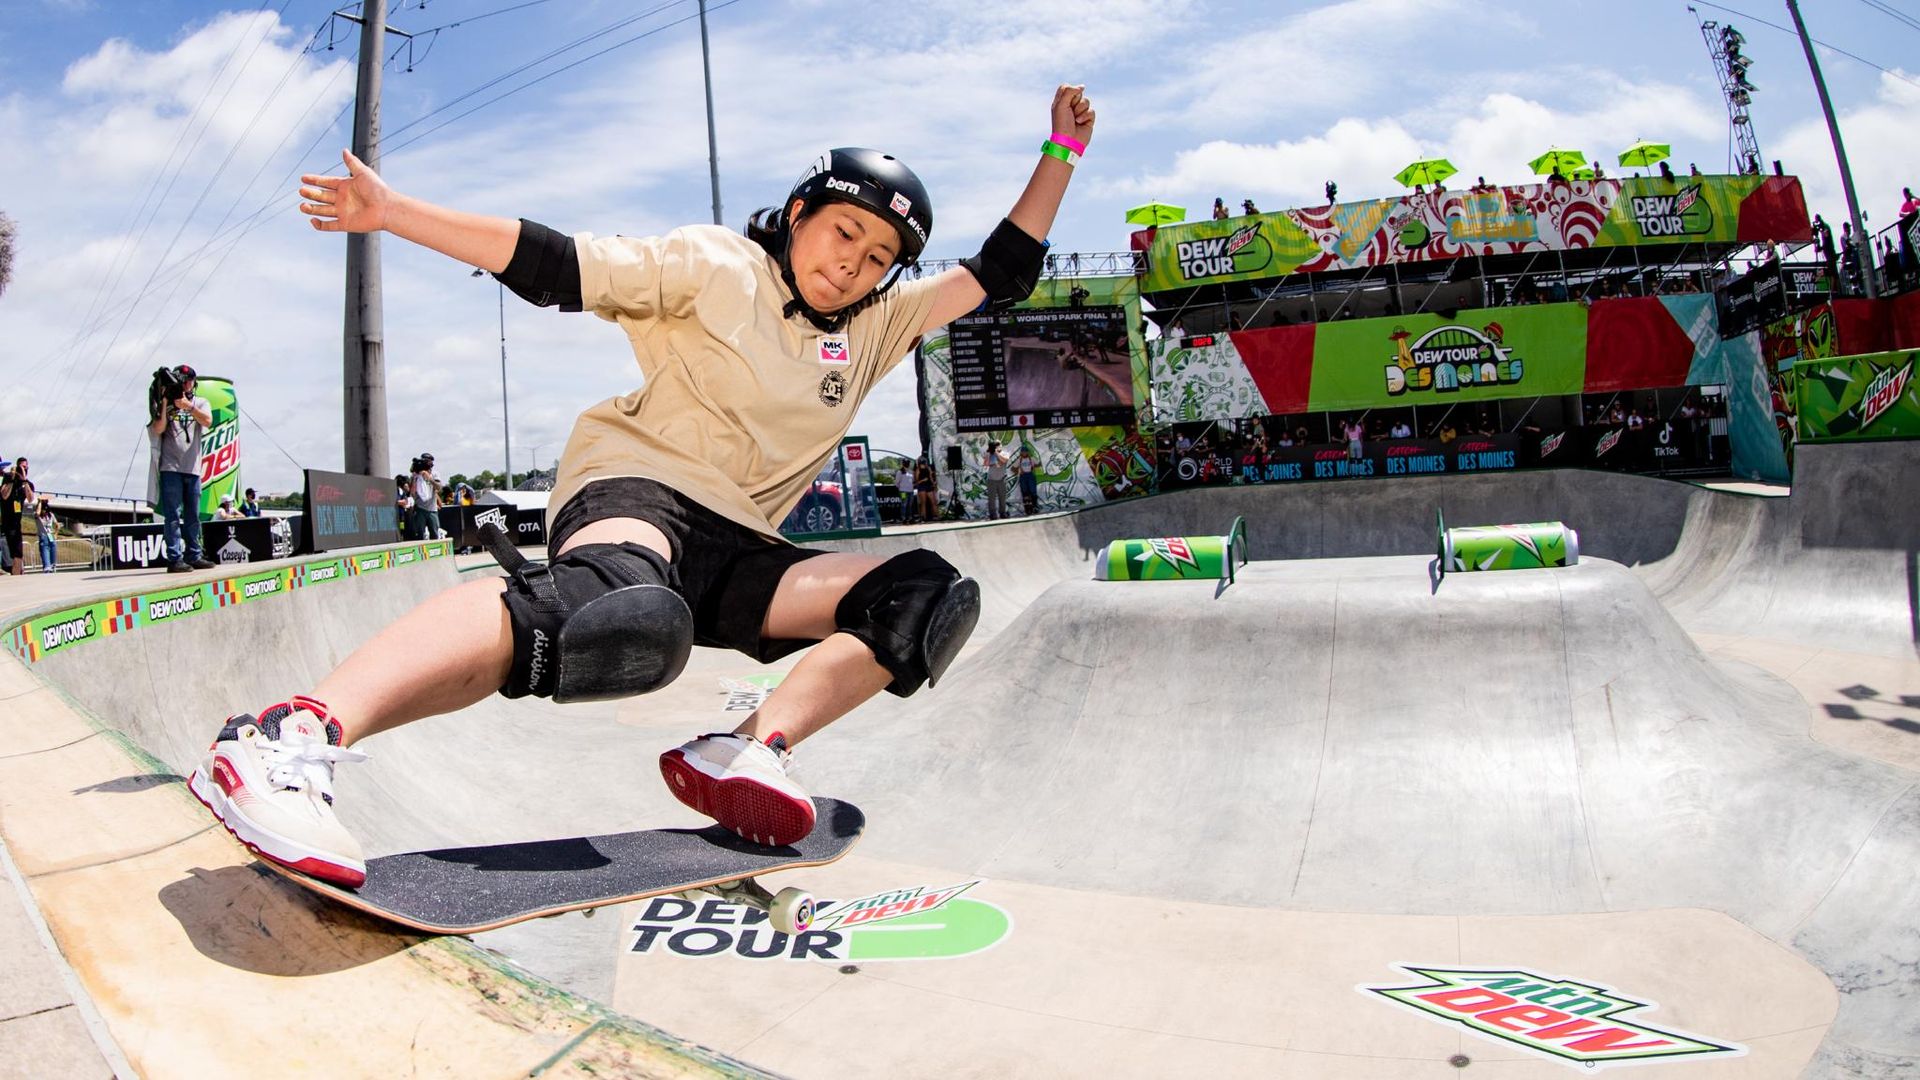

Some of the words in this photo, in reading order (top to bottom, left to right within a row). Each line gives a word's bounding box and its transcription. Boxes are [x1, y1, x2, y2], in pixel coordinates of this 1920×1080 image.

[826, 177, 860, 195] bern
[1633, 196, 1673, 217] DEW
[1637, 215, 1685, 236] TOUR
[1177, 238, 1226, 261] DEW
[1181, 256, 1235, 279] TOUR
[1793, 272, 1813, 283] DEW
[1016, 314, 1058, 323] WOMEN'S
[1059, 313, 1083, 321] PARK
[1083, 312, 1108, 320] FINAL
[823, 341, 843, 349] MK
[1458, 453, 1477, 470] DES
[1479, 450, 1515, 468] MOINES
[1654, 447, 1679, 456] TikTok
[1199, 457, 1233, 468] WRLD
[1314, 461, 1334, 478] DES
[1387, 457, 1406, 474] DES
[1408, 455, 1445, 473] MOINES
[518, 522, 540, 533] OTA
[222, 549, 247, 564] Casey's
[245, 577, 276, 598] DEWTOUR
[150, 595, 195, 621] DEWTOUR
[43, 619, 87, 650] DEWTOUR
[528, 628, 549, 691] division
[725, 691, 761, 711] DEW
[631, 923, 844, 960] TOUR
